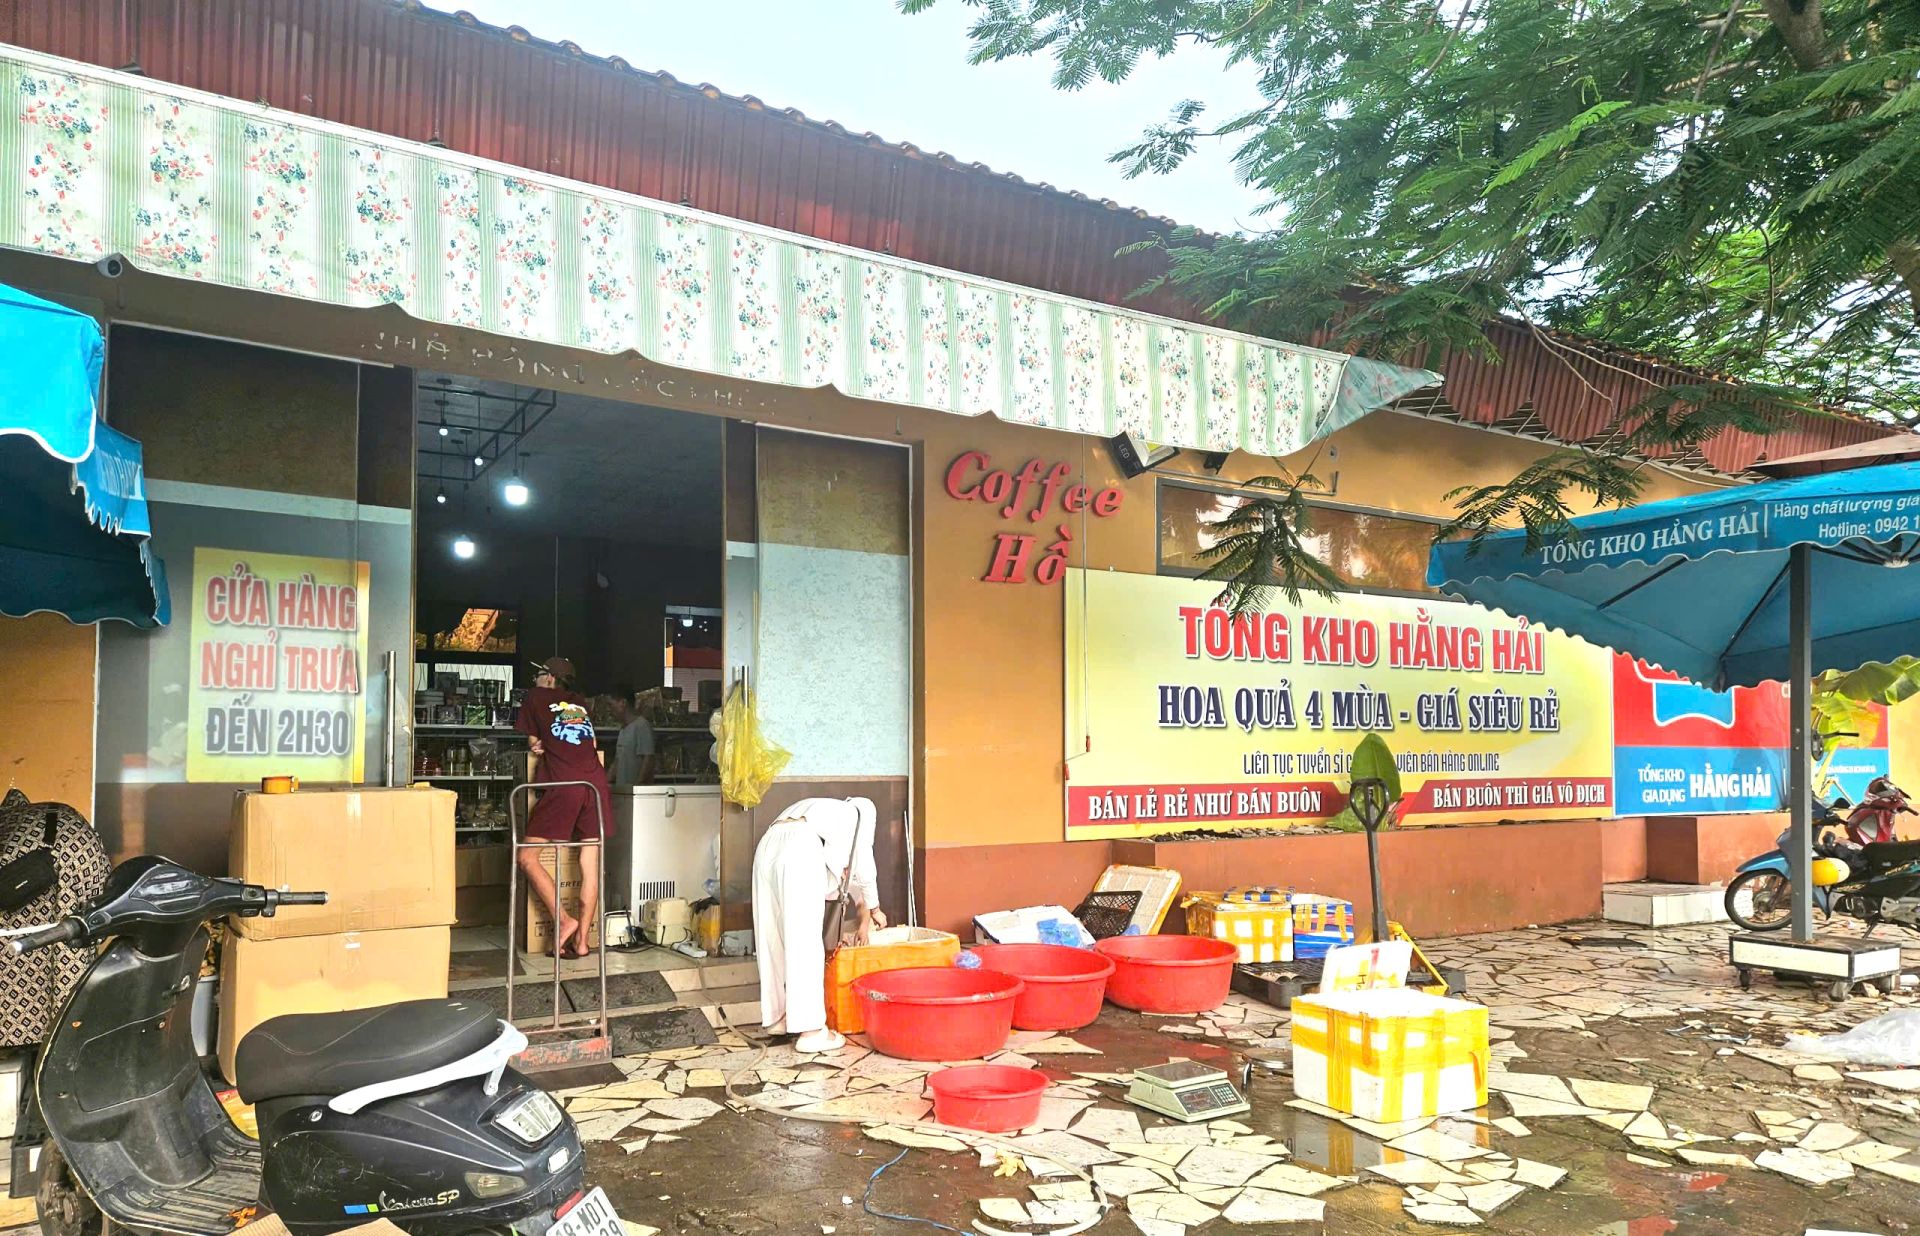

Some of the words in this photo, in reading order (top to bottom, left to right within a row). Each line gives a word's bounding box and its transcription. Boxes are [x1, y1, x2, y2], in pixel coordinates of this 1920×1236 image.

[1119, 444, 1130, 459] LED
[945, 450, 1124, 522] Coffee
[1774, 502, 1809, 519] Hàng
[1812, 499, 1843, 515] chất
[1845, 499, 1892, 514] lượng
[1819, 523, 1871, 538] Hotline:
[1874, 515, 1909, 533] 0942
[1600, 532, 1646, 557] KHO
[1651, 518, 1713, 550] HẰNG
[1718, 506, 1759, 538] HẢI
[981, 523, 1074, 585] Hồ
[207, 562, 269, 625] CỬA
[277, 573, 357, 631] HÀNG
[1302, 614, 1377, 667] KHO
[1389, 606, 1483, 672] HẰNG
[1492, 615, 1545, 674] HẢI
[201, 630, 276, 690] NGHỈ
[284, 645, 358, 693] TRƯA
[206, 693, 268, 753] ĐẾN
[276, 709, 351, 754] 2H30
[1158, 684, 1226, 727] HOA
[1234, 678, 1297, 732] QUẢ
[1305, 690, 1323, 729] 4
[1332, 683, 1393, 729] MÙA
[1416, 687, 1460, 730] GIÁ
[1468, 689, 1522, 731] SIÊU
[1529, 689, 1559, 731] RẺ
[1243, 750, 1269, 774] LIÊN
[1274, 753, 1294, 778] TỤC
[1297, 747, 1331, 774] TUYỂN
[1420, 750, 1439, 772] BÁN
[1442, 750, 1465, 772] HÀNG
[1468, 753, 1500, 772] ONLINE
[1665, 768, 1686, 782] KHO
[1689, 761, 1740, 798] HẰNG
[1741, 766, 1771, 797] HẢI
[1088, 790, 1128, 820] BÁN
[1134, 788, 1158, 818] LẺ
[1163, 787, 1188, 817] RẺ
[1193, 790, 1233, 817] NHƯ
[1237, 787, 1274, 815] BÁN
[1277, 788, 1322, 813] BUÔN
[1433, 784, 1462, 808] BÁN
[1465, 782, 1502, 807] BUÔN
[1505, 783, 1529, 805] THÌ
[1532, 783, 1554, 804] GIÁ
[1557, 784, 1574, 804] VÔ
[1576, 783, 1606, 807] ĐỊCH
[437, 1189, 460, 1206] SP
